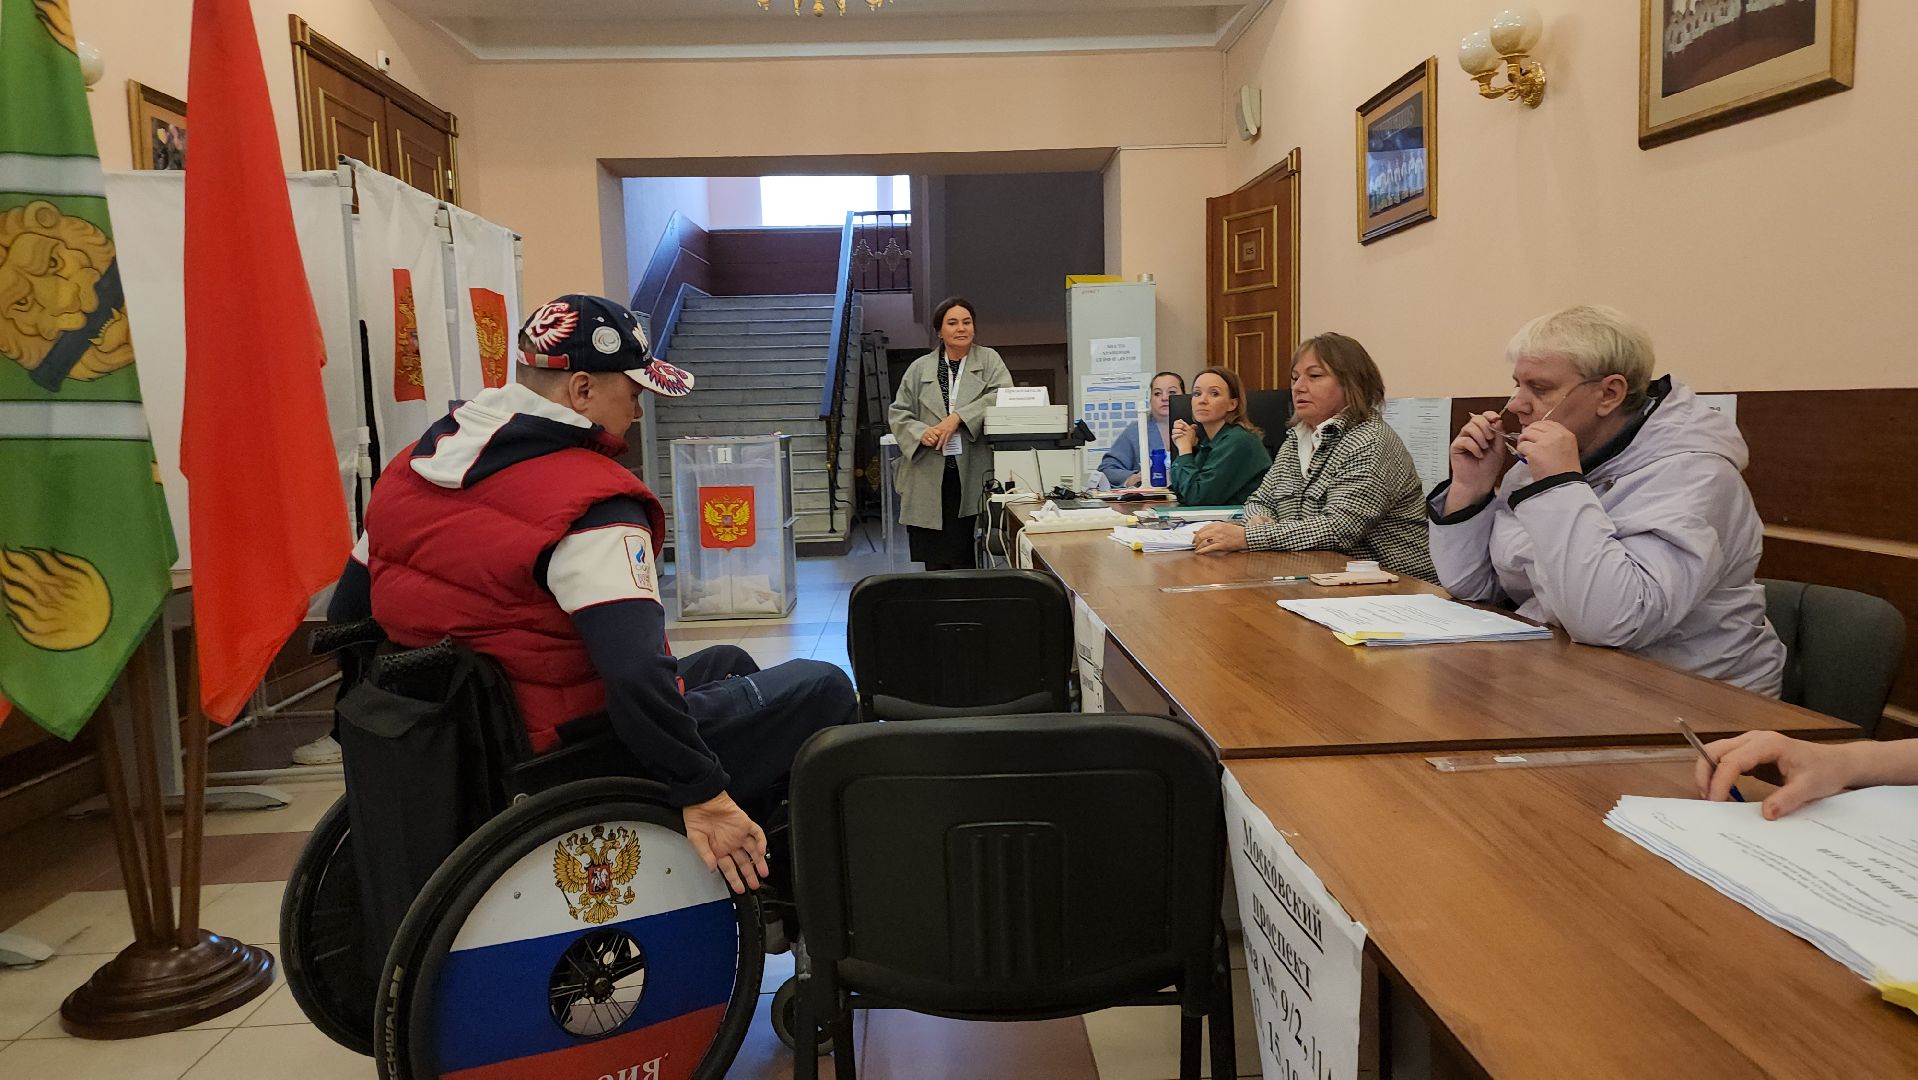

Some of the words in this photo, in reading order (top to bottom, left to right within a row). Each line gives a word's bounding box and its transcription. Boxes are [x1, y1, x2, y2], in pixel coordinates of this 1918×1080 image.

[1243, 817, 1323, 944] Московский
[1253, 892, 1312, 988] проспект
[1281, 989, 1308, 1061] 9/2,
